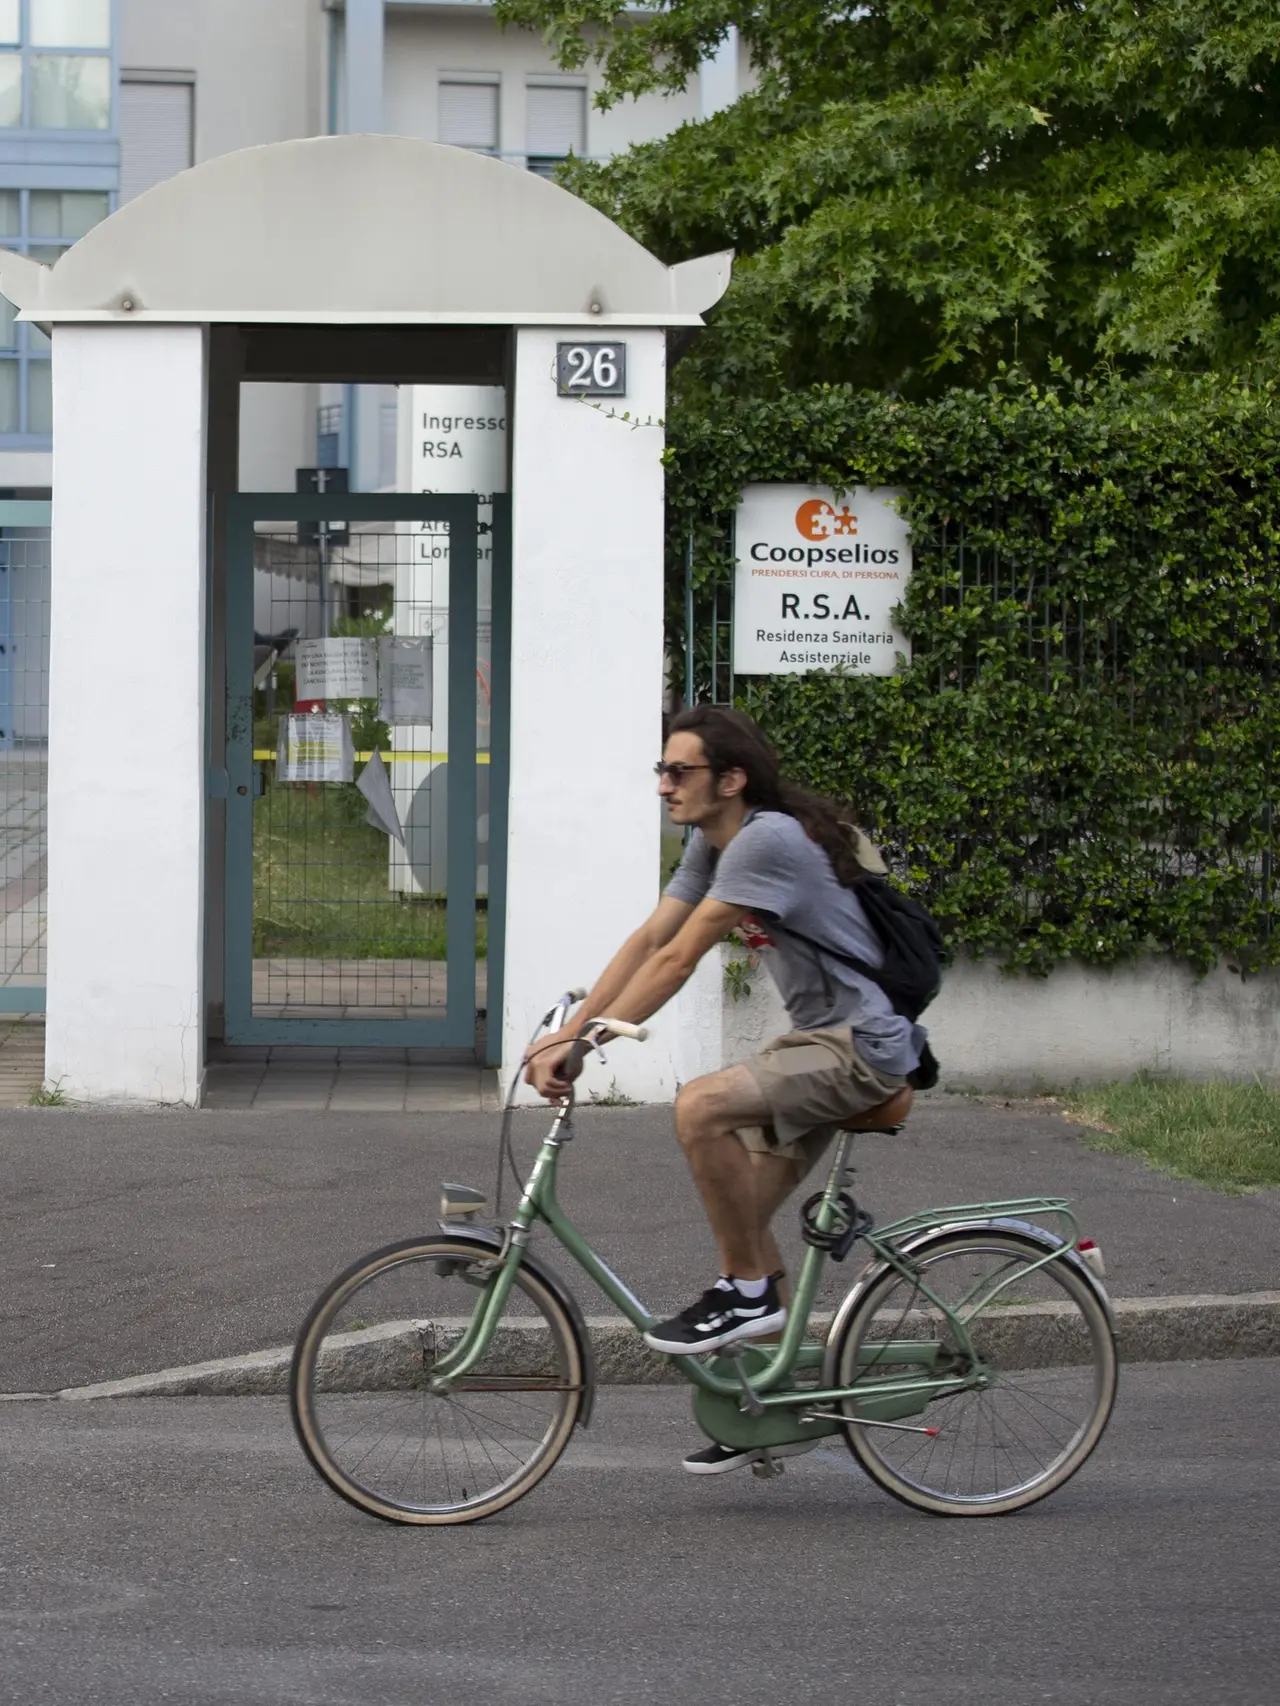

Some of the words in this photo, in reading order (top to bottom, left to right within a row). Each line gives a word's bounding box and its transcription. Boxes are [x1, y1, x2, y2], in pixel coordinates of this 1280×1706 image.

[567, 347, 618, 388] 26
[422, 441, 463, 459] RSA
[750, 542, 899, 567] Coopselios
[751, 569, 808, 578] PRENDERSI
[842, 571, 853, 579] DI
[855, 571, 900, 580] PERSONA
[781, 593, 871, 621] R.S.A.
[756, 629, 829, 643] Residenza
[832, 630, 894, 644] Sanitaria
[779, 650, 871, 664] Assistenziale
